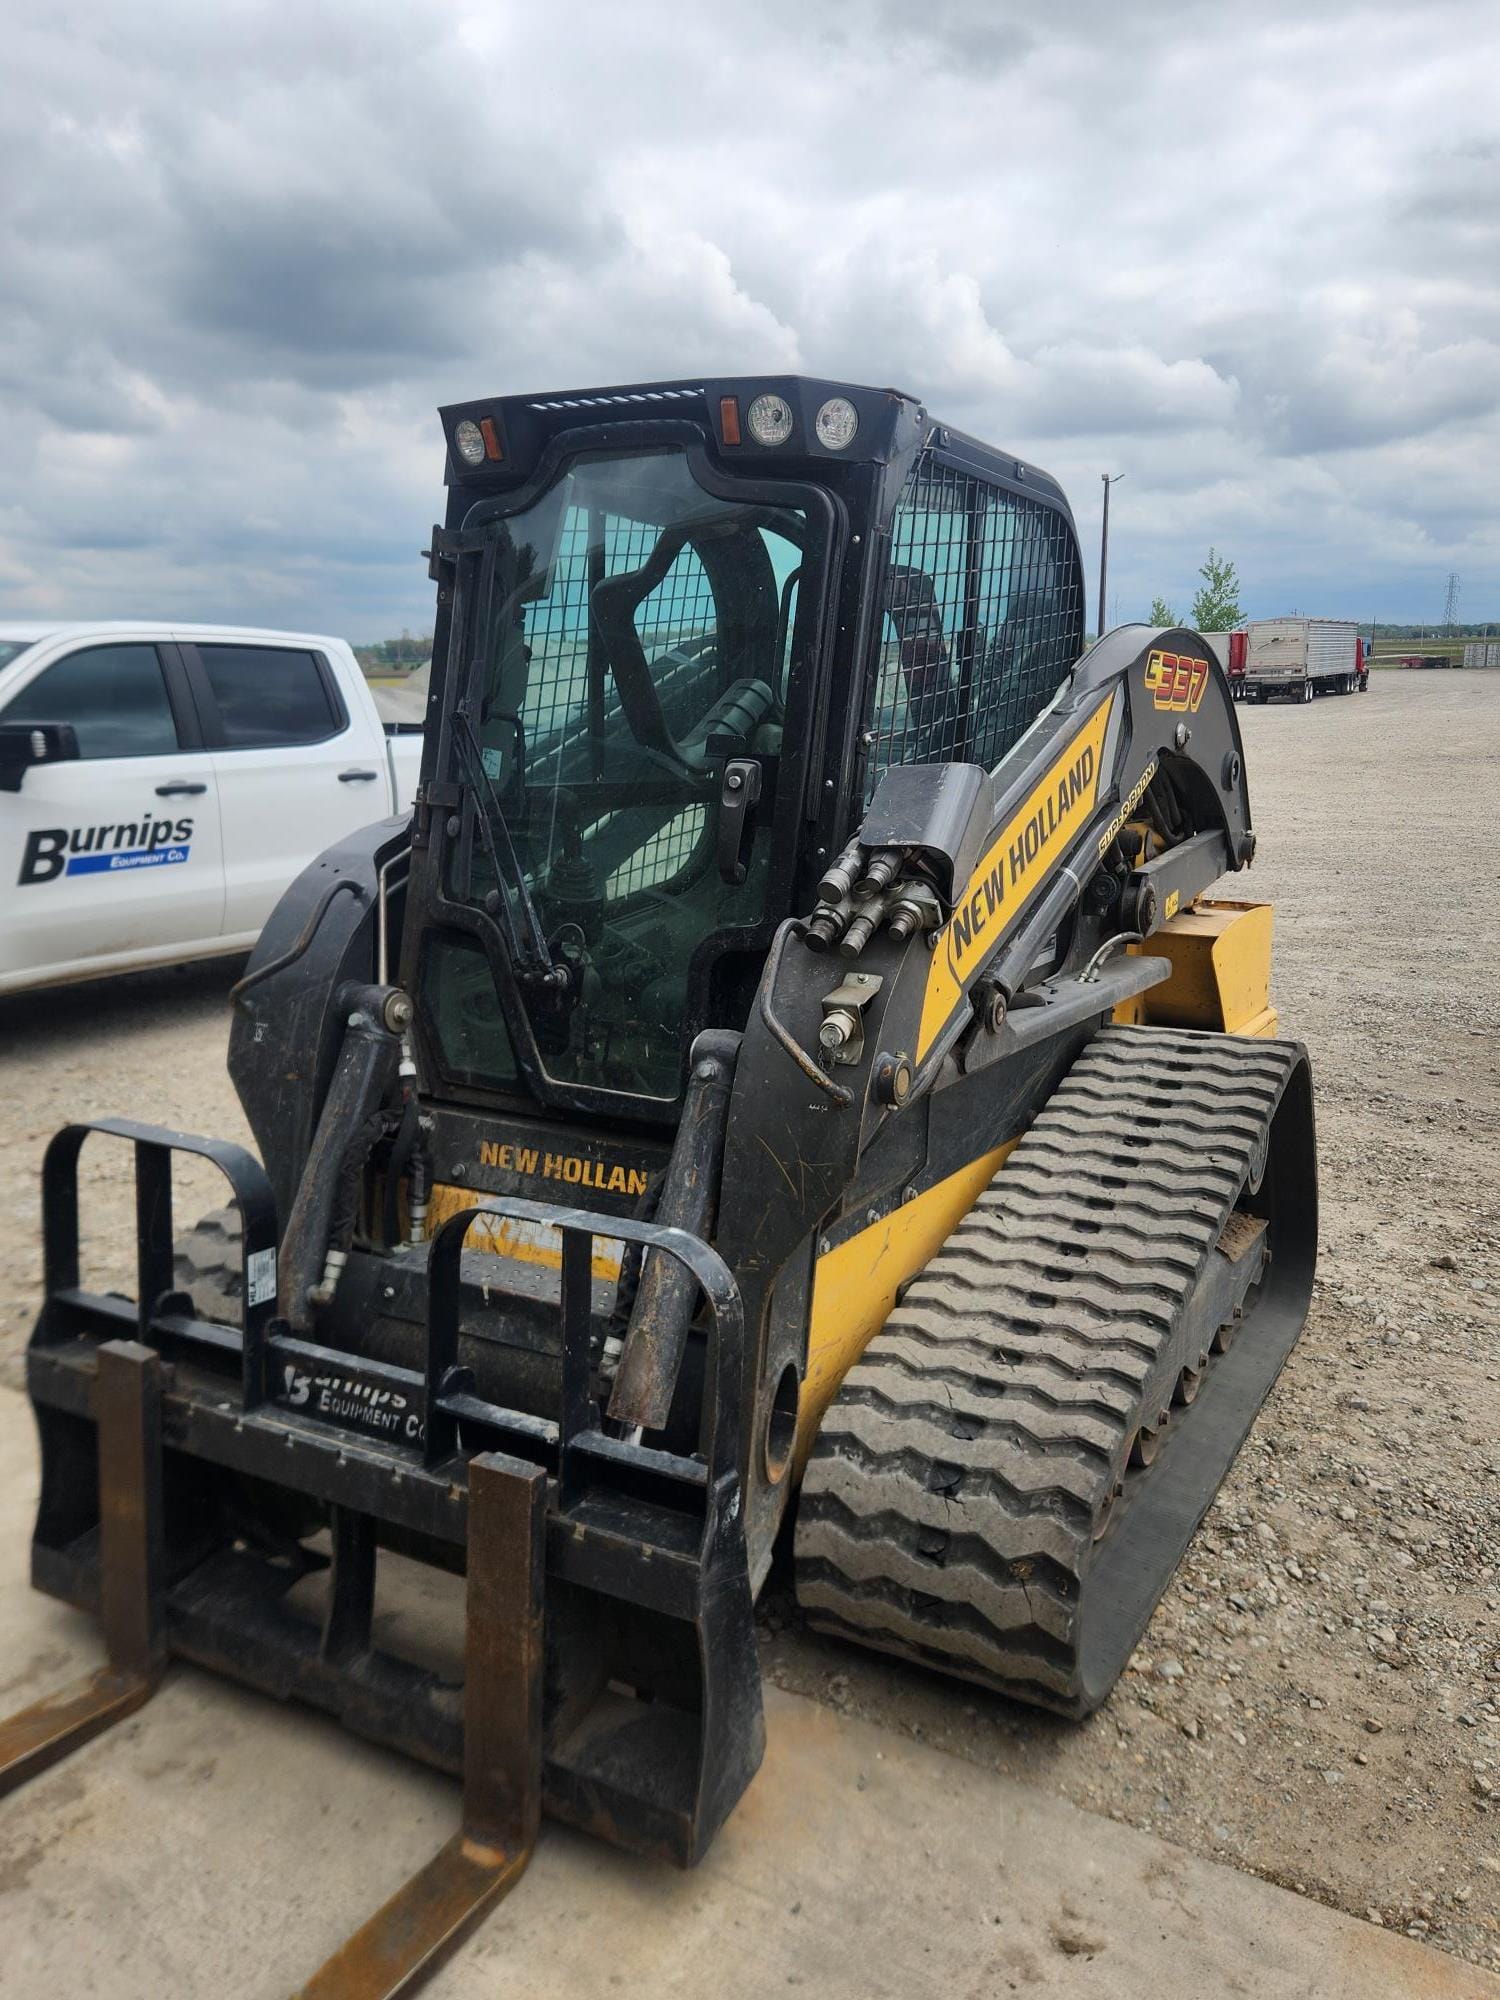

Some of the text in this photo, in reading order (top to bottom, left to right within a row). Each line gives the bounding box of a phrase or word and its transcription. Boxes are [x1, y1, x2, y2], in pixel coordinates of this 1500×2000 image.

[17, 813, 194, 887] Burnips
[952, 745, 1095, 961] NEW HOLLAND
[479, 1140, 649, 1196] NEW HOLLAN
[319, 1389, 401, 1431] EQUIPMENT
